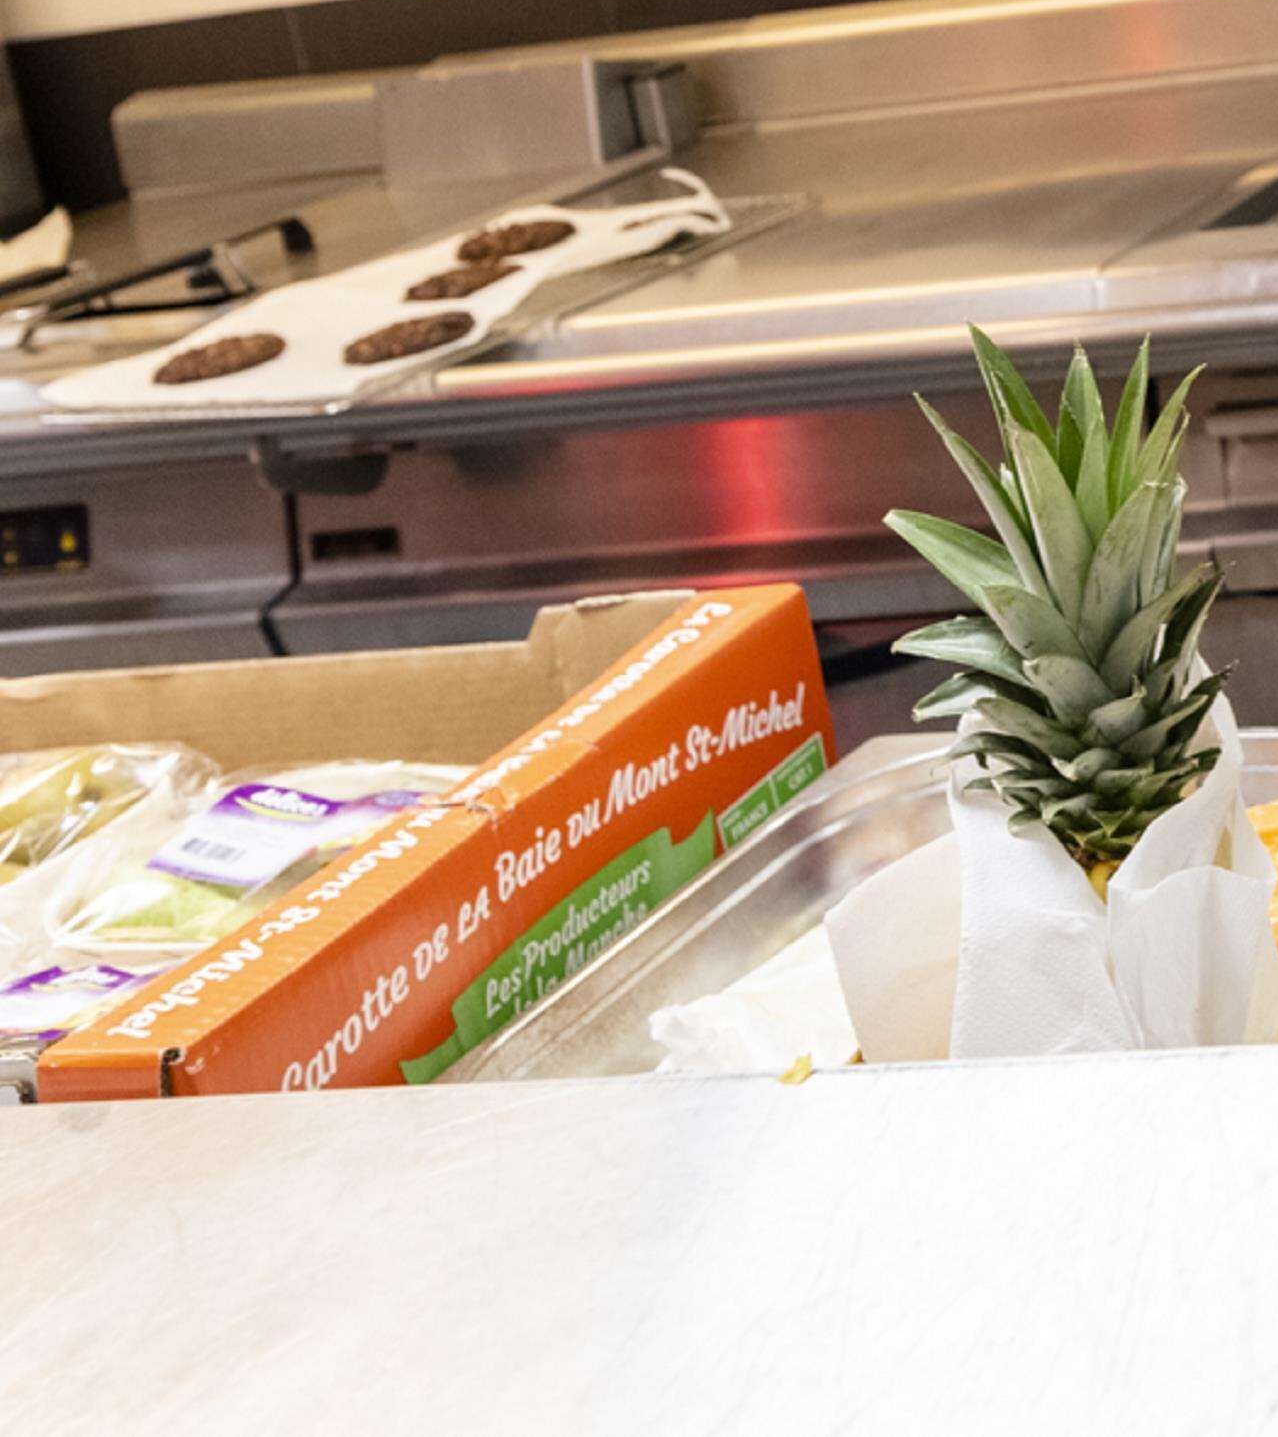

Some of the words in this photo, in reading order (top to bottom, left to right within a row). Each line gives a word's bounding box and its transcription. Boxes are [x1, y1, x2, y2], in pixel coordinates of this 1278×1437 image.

[281, 965, 409, 1091] Carotte
[494, 826, 562, 902] Baie
[602, 743, 680, 824] Mont
[685, 681, 806, 771] St-Michel
[307, 829, 418, 901] Mont
[106, 906, 320, 1039] St-Michel
[486, 967, 522, 1020] Les
[522, 860, 652, 981] Producteurs
